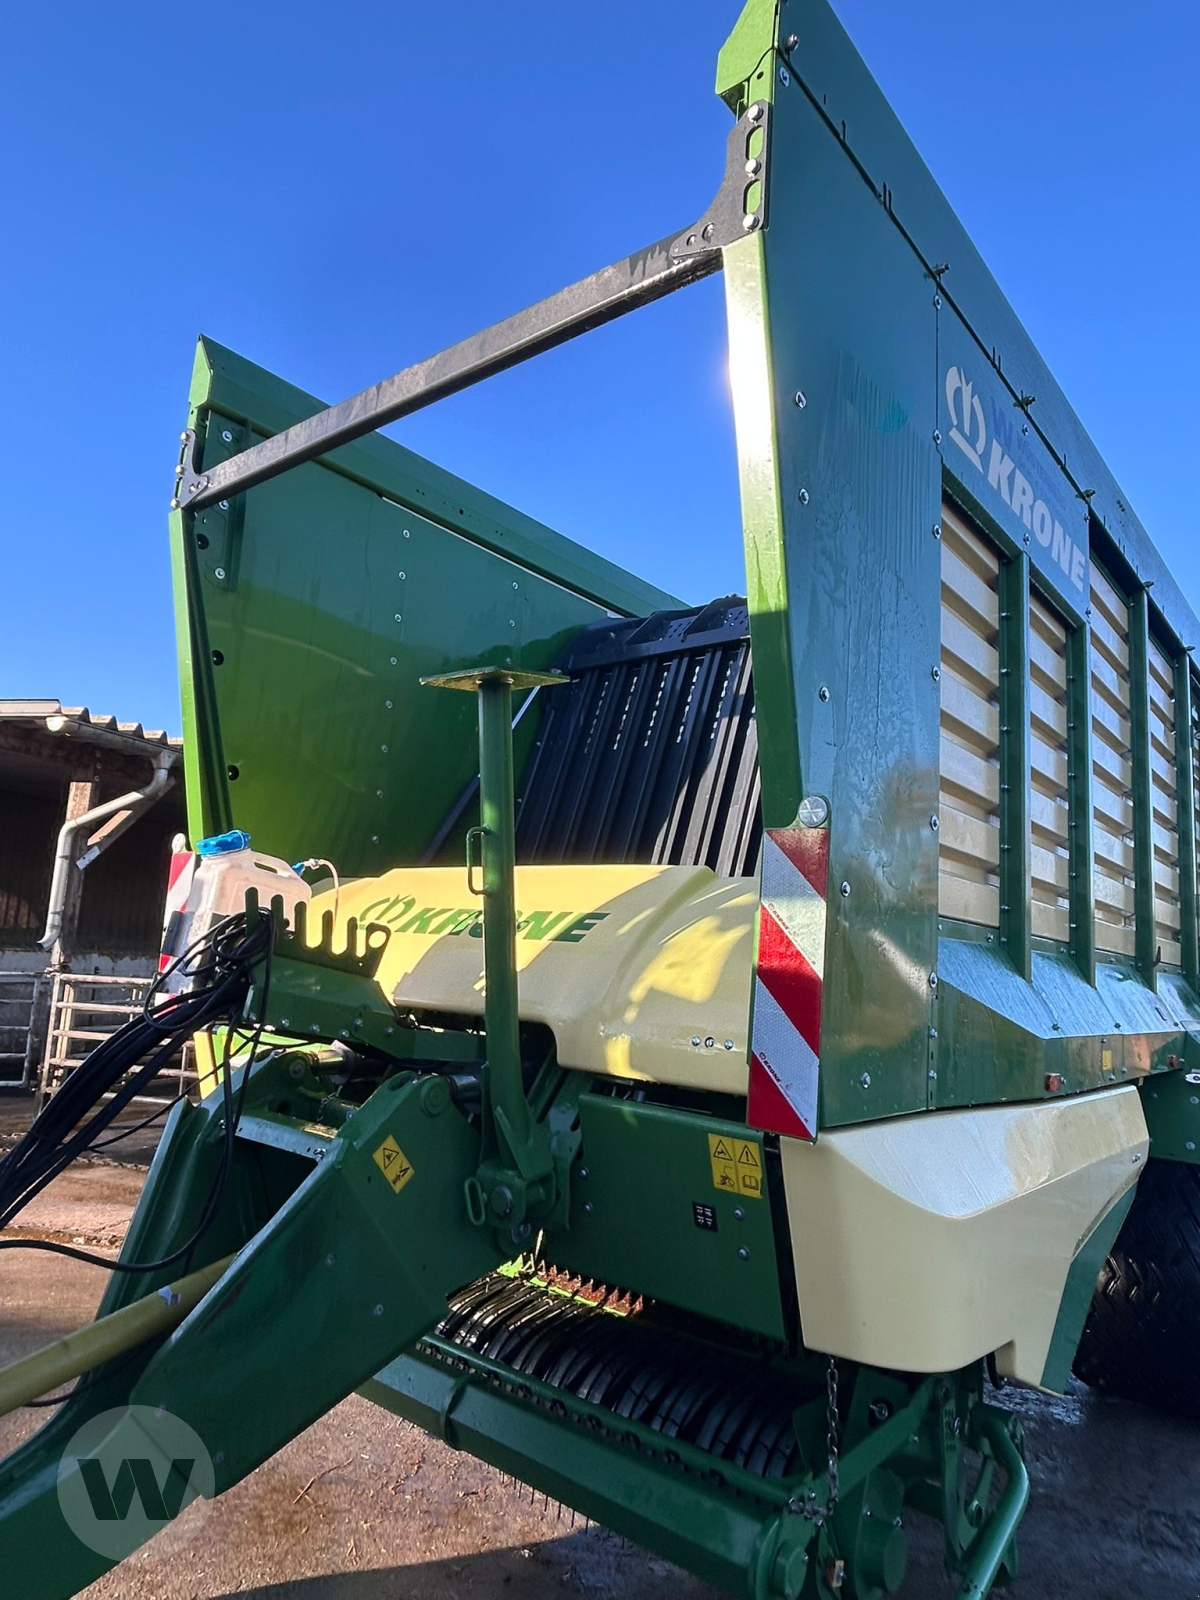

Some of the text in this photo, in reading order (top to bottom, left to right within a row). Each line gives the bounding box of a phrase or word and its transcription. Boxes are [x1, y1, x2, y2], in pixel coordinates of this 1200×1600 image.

[987, 438, 1087, 593] KRONE
[772, 910, 790, 930] KRONE
[763, 1060, 782, 1082] KRONE
